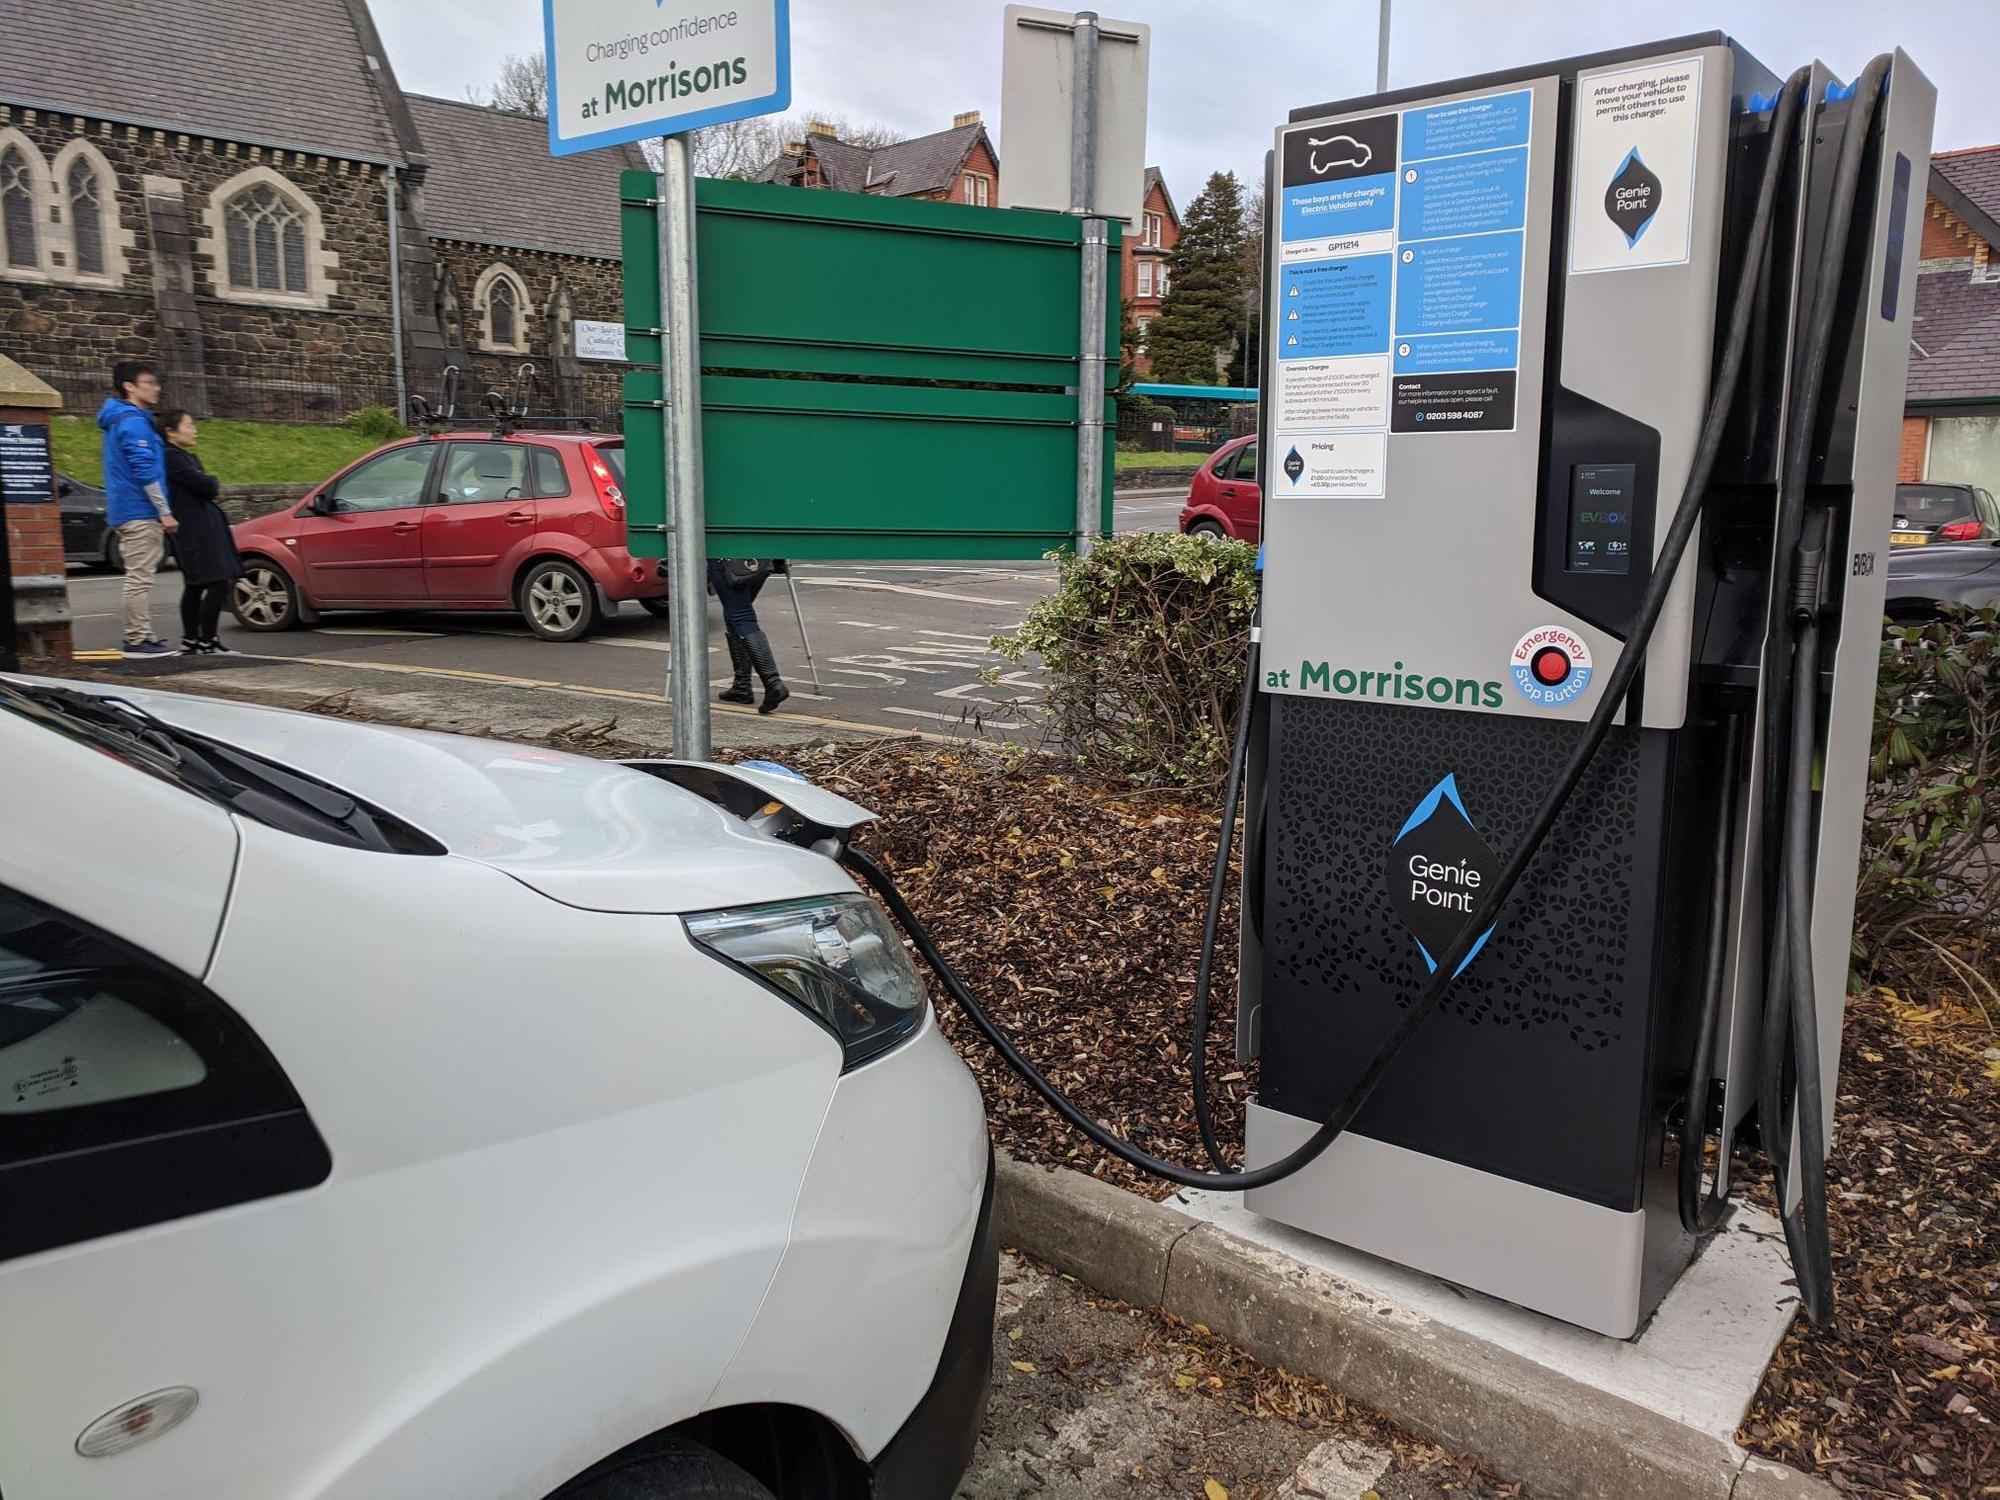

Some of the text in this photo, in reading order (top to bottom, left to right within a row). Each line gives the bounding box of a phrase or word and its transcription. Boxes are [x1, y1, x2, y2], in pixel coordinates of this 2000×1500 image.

[586, 10, 738, 62] Charging confidence
[582, 56, 748, 118] at Morrisons
[1594, 74, 1690, 96] After charging, please
[1596, 96, 1620, 106] move
[1622, 94, 1642, 104] your
[1644, 86, 1676, 98] vehicle
[1596, 104, 1626, 116] permit
[1627, 100, 1656, 110] others
[1669, 94, 1686, 103] use
[1612, 108, 1666, 122] this charger.
[1292, 198, 1312, 206] These
[1312, 195, 1330, 204] bays
[1354, 187, 1386, 198] charging
[1616, 183, 1651, 199] Genie
[1302, 198, 1374, 214] Electric Vehicles only
[1617, 198, 1648, 211] Point
[1328, 241, 1360, 251] GP11214
[1463, 411, 1483, 419] 4087
[1312, 443, 1334, 451] Pricing
[1515, 630, 1586, 660] Emergency
[1266, 660, 1504, 708] at Morrisons
[1516, 669, 1586, 702] Stop Button
[1408, 855, 1481, 888] Genie
[1411, 880, 1474, 913] Point
